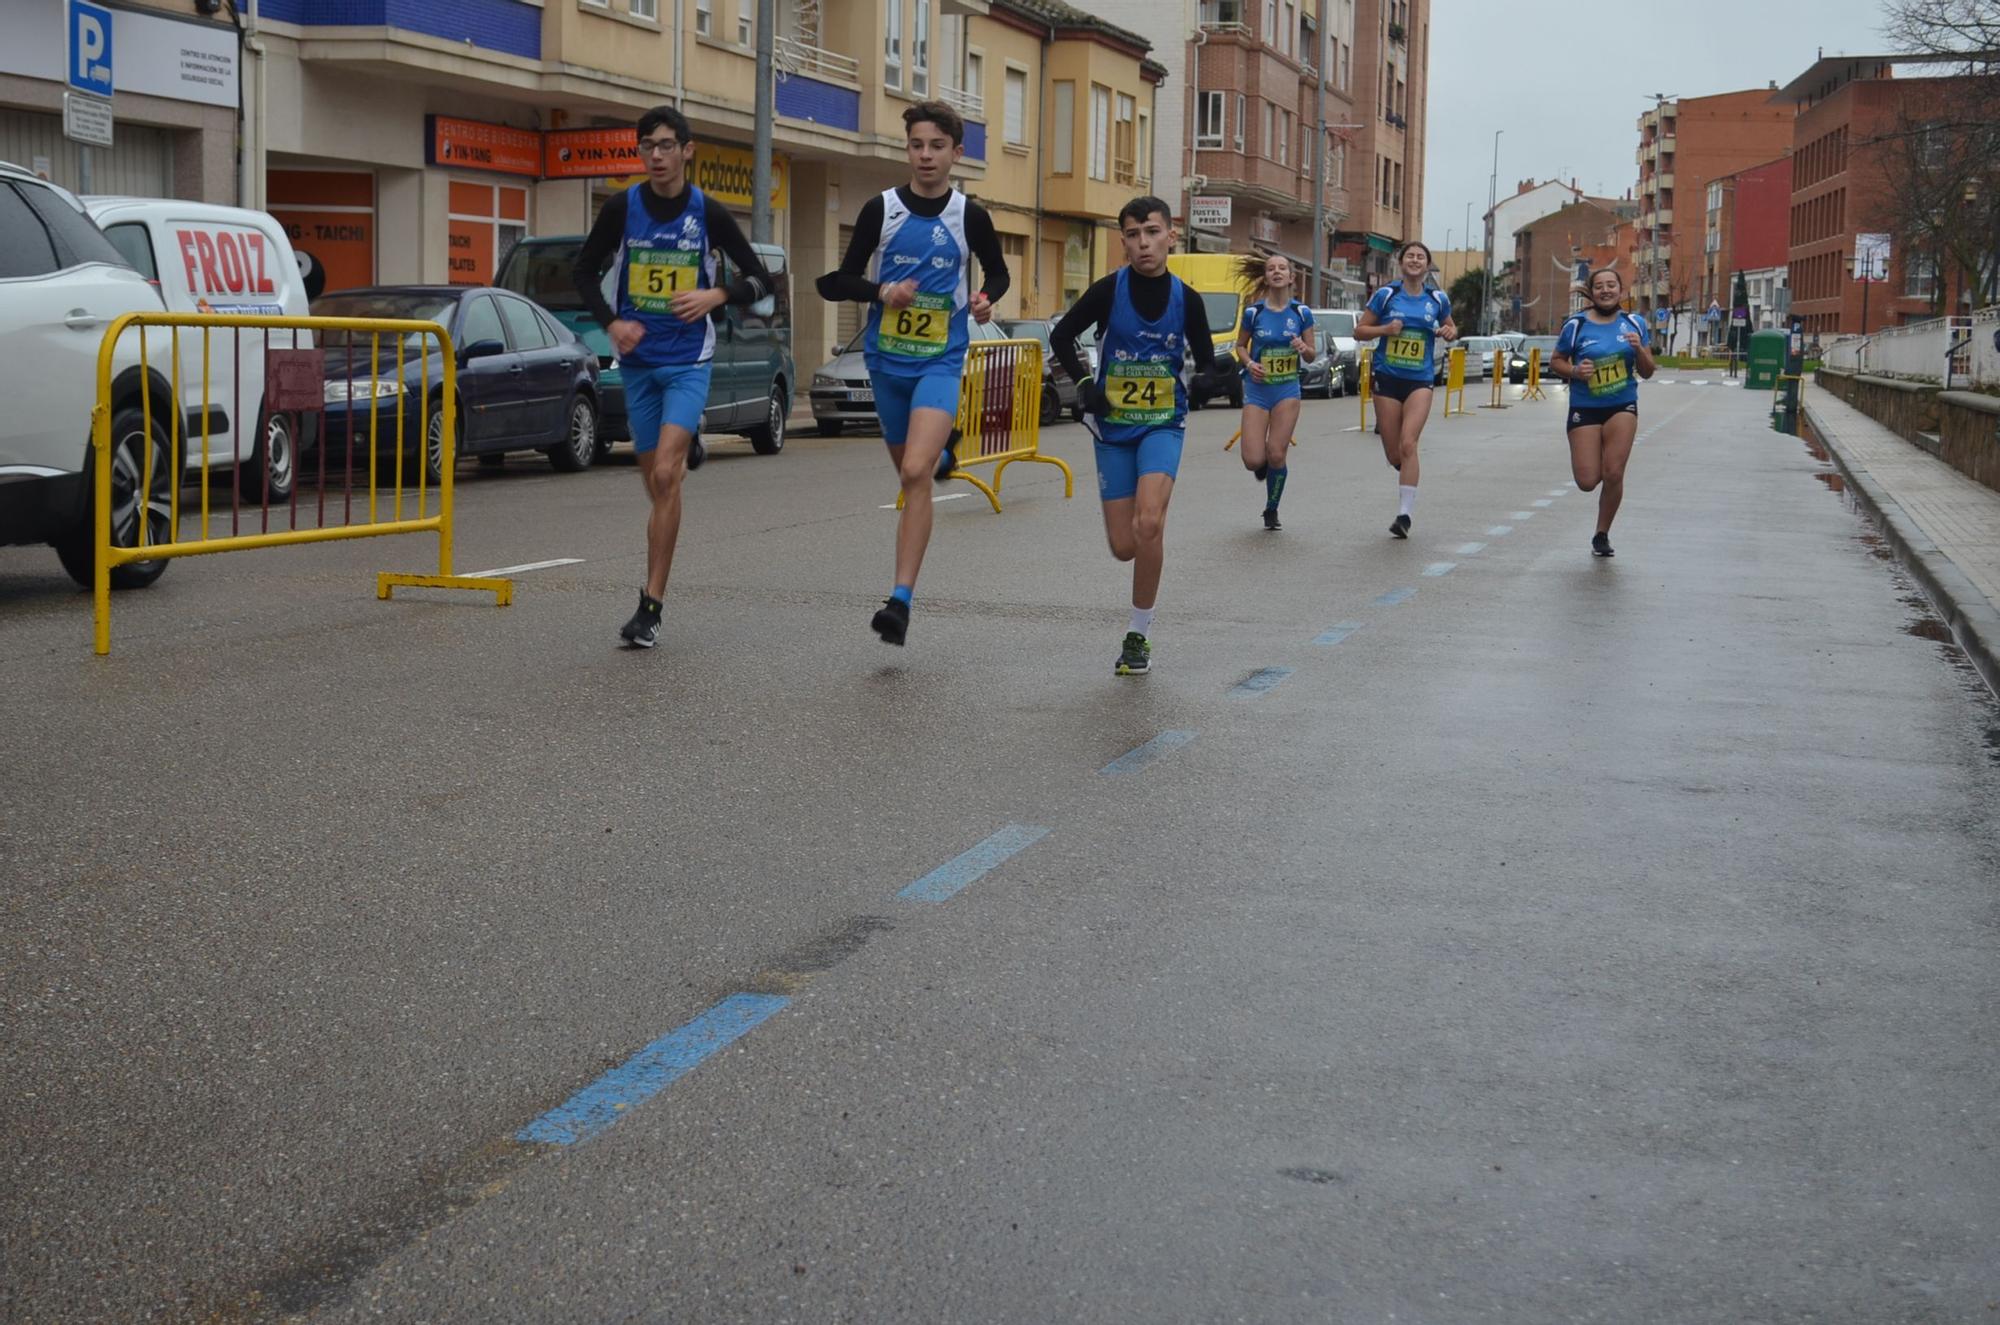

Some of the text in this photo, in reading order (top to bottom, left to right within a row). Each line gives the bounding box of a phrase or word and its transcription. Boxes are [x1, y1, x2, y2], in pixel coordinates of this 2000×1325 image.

[79, 13, 104, 78] P
[604, 128, 638, 143] BIENE
[453, 144, 492, 164] YIN-YANG
[576, 146, 639, 160] YIN-YAN
[1192, 209, 1221, 217] JUSTEL
[1199, 217, 1228, 225] PRIETO
[314, 224, 364, 240] TAICHI
[175, 230, 275, 295] FROIZ
[648, 269, 678, 293] 51
[897, 310, 932, 337] 62
[1392, 339, 1420, 357] 179
[1267, 358, 1292, 374] 131
[1593, 364, 1619, 384] 171
[1122, 381, 1157, 406] 24
[1124, 412, 1171, 420] CAJA RURAL
